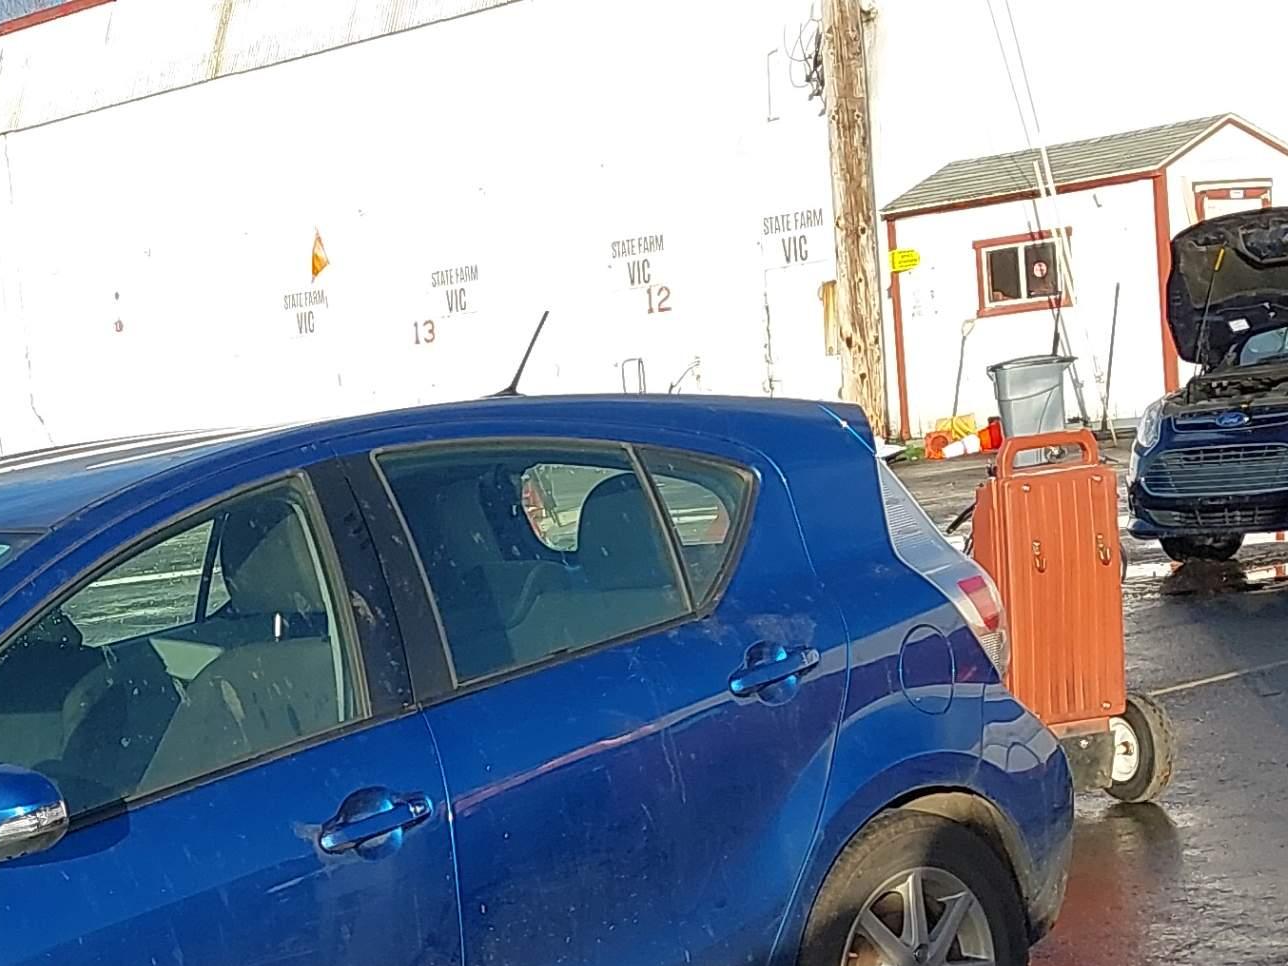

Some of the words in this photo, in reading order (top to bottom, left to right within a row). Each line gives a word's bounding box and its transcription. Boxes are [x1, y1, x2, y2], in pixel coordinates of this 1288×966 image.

[763, 213, 792, 235] STATE
[794, 207, 824, 230] FARM
[611, 238, 637, 259] STATE
[638, 234, 664, 254] FARM
[781, 234, 809, 264] VIC
[431, 270, 454, 288] STATE
[455, 263, 479, 284] FARM
[627, 258, 651, 286] VIC
[283, 292, 304, 310] STATE
[445, 287, 467, 313] VIC
[646, 286, 672, 314] 12
[296, 310, 315, 334] VIC
[414, 319, 436, 344] 13
